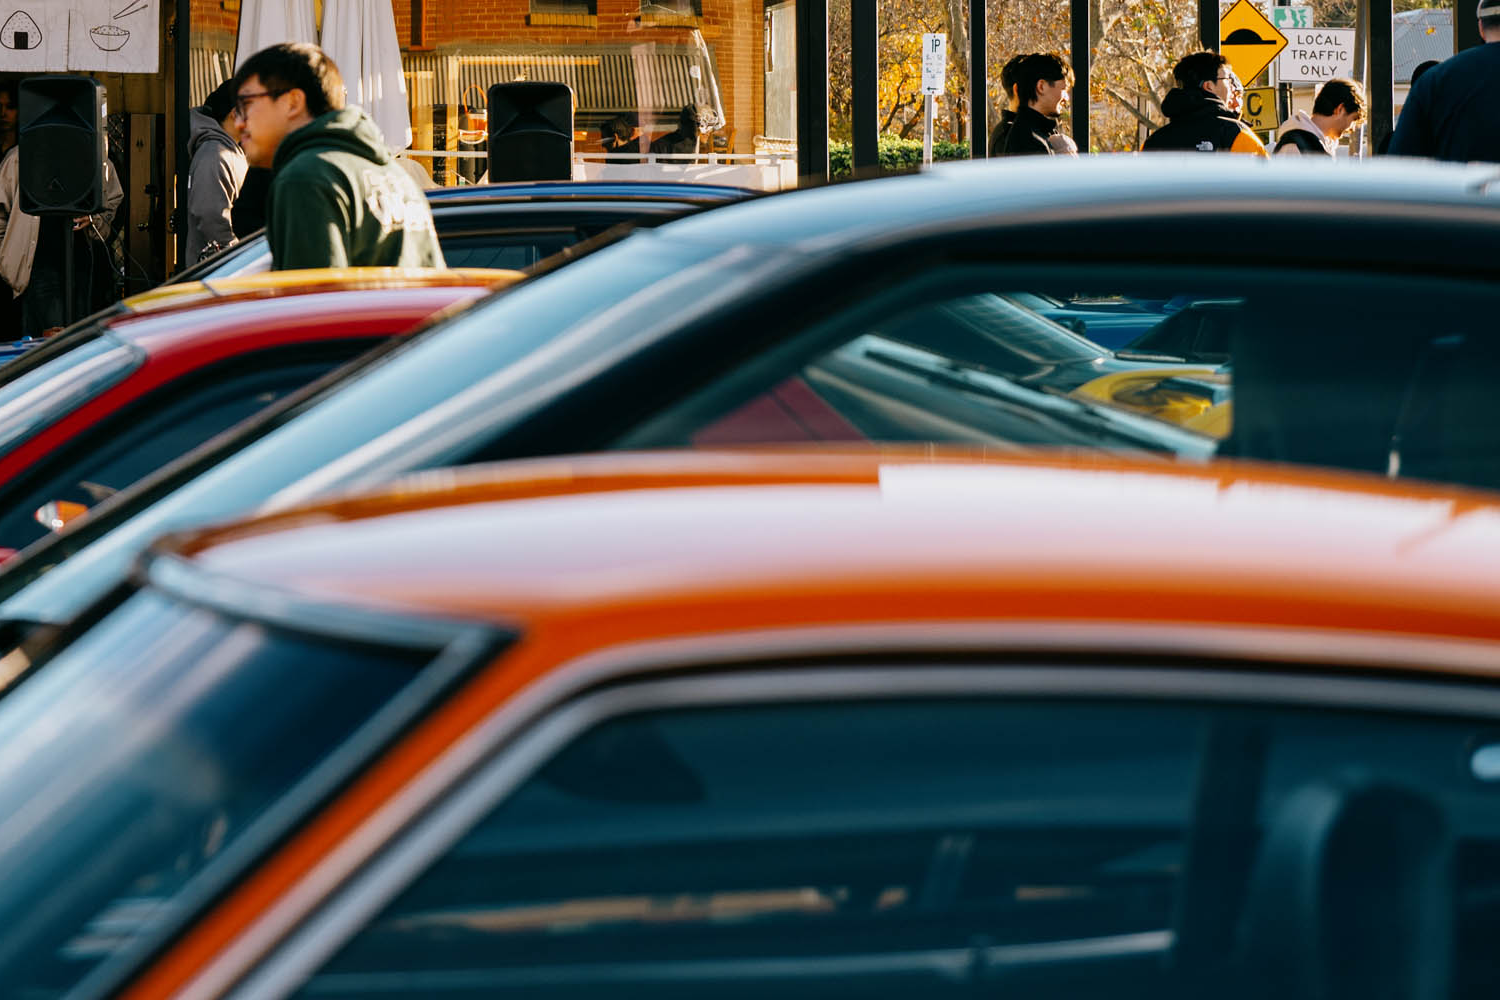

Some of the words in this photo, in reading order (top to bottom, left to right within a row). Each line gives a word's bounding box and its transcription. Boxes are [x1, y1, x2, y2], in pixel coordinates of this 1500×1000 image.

[1297, 34, 1342, 46] LOCAL
[1291, 50, 1348, 61] TRAFFIC
[1300, 65, 1338, 77] ONLY
